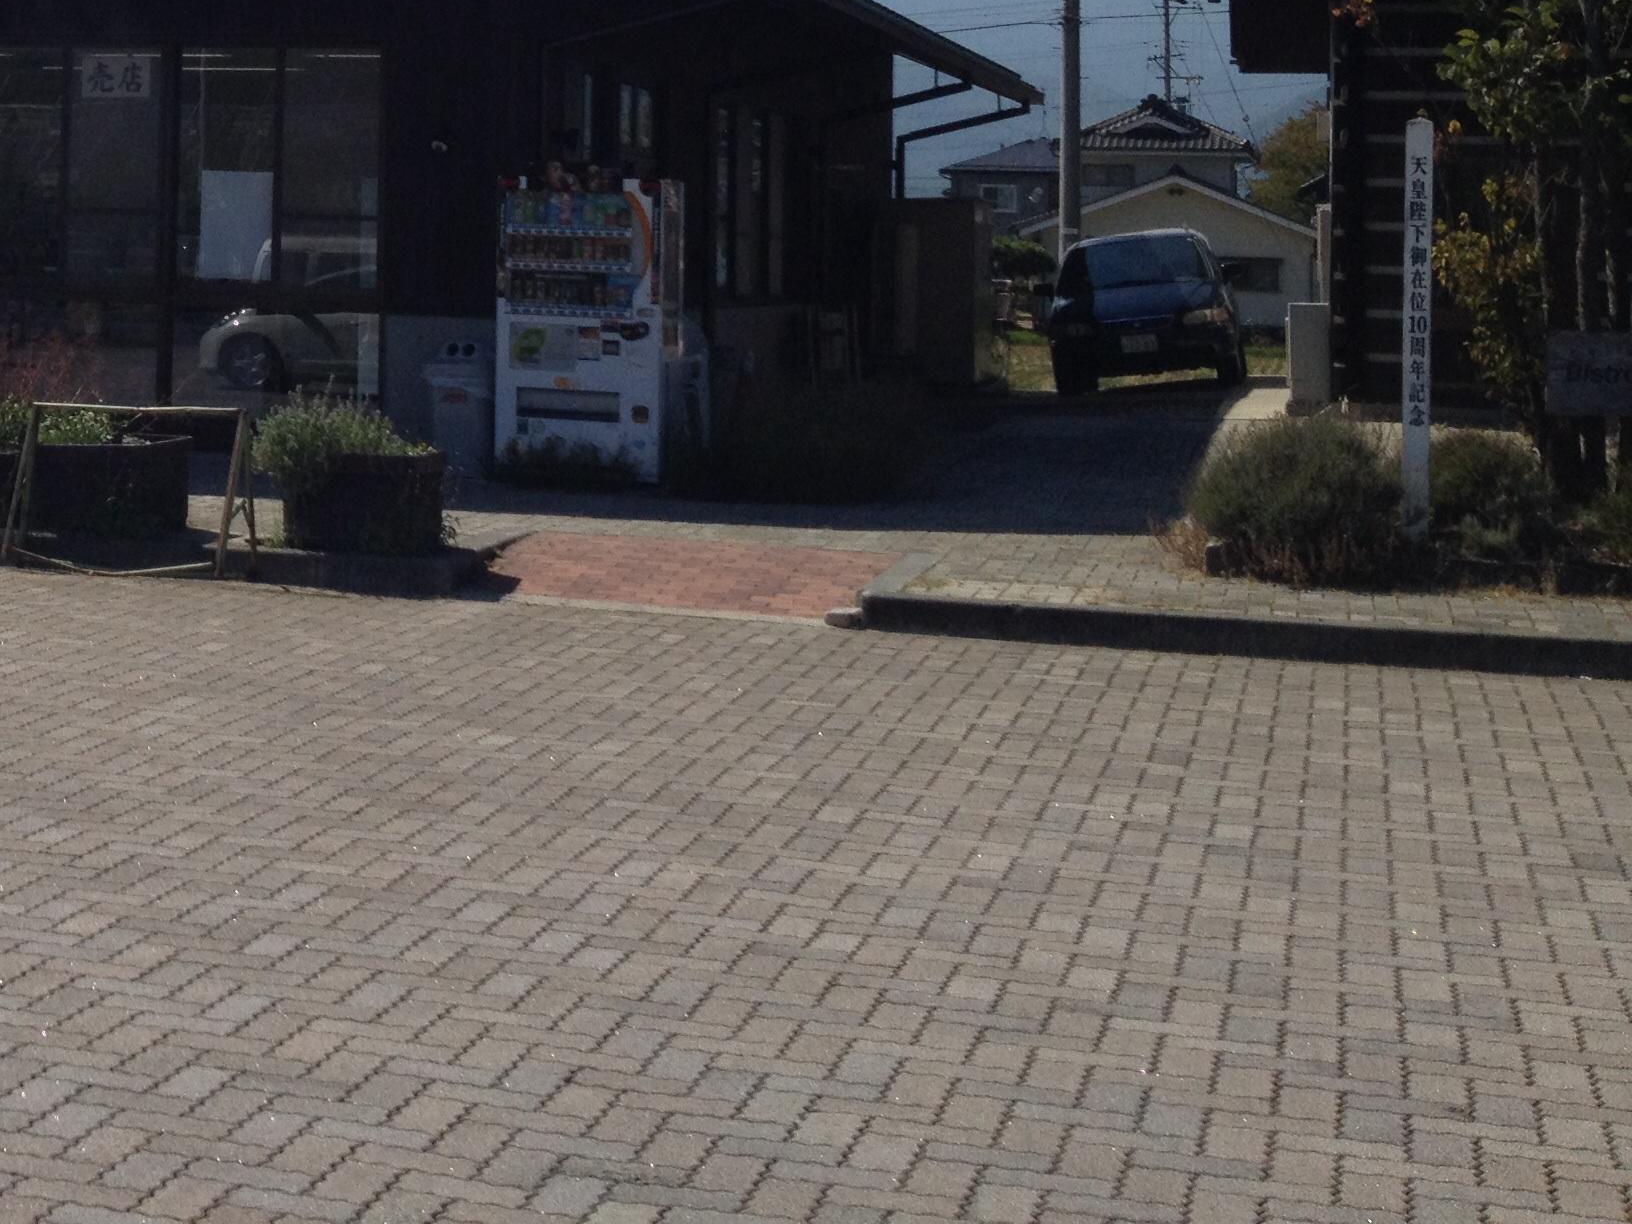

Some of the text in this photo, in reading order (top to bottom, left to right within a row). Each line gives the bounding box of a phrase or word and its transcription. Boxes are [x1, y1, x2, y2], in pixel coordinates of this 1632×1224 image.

[87, 61, 143, 93] 売店
[1408, 156, 1428, 427] 天皇陛下御在位10周年記念
